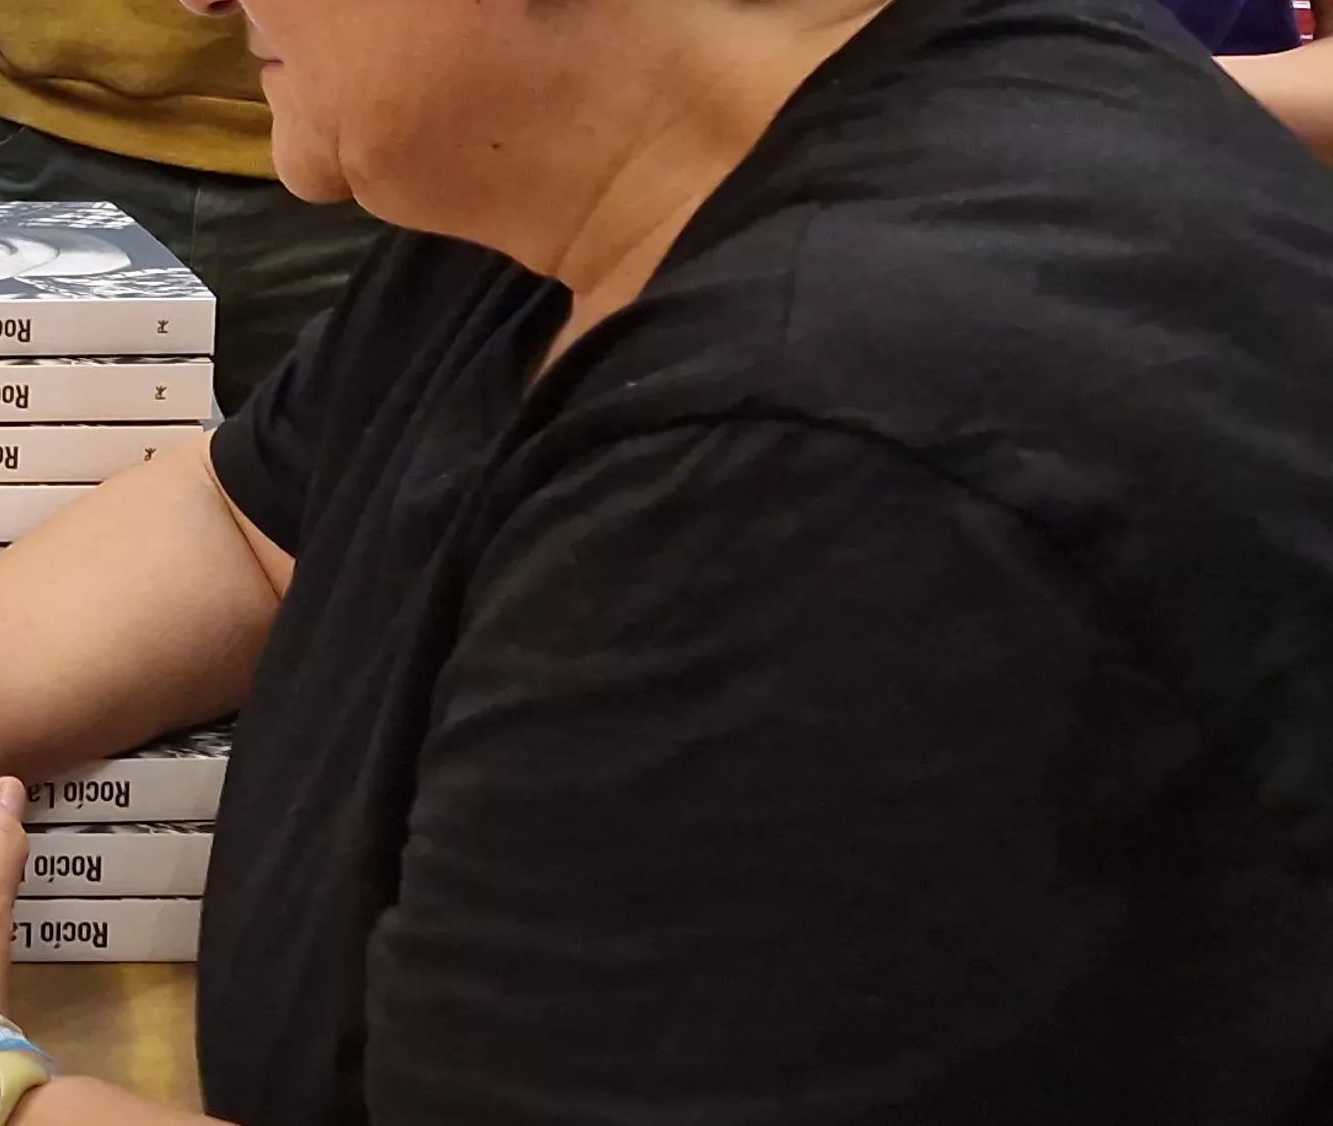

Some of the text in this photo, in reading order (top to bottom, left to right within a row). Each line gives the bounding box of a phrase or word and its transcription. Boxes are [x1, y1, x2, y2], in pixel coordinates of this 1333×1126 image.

[63, 779, 131, 810] Rocío
[34, 854, 103, 883] Rocío
[40, 920, 109, 950] Rocío
